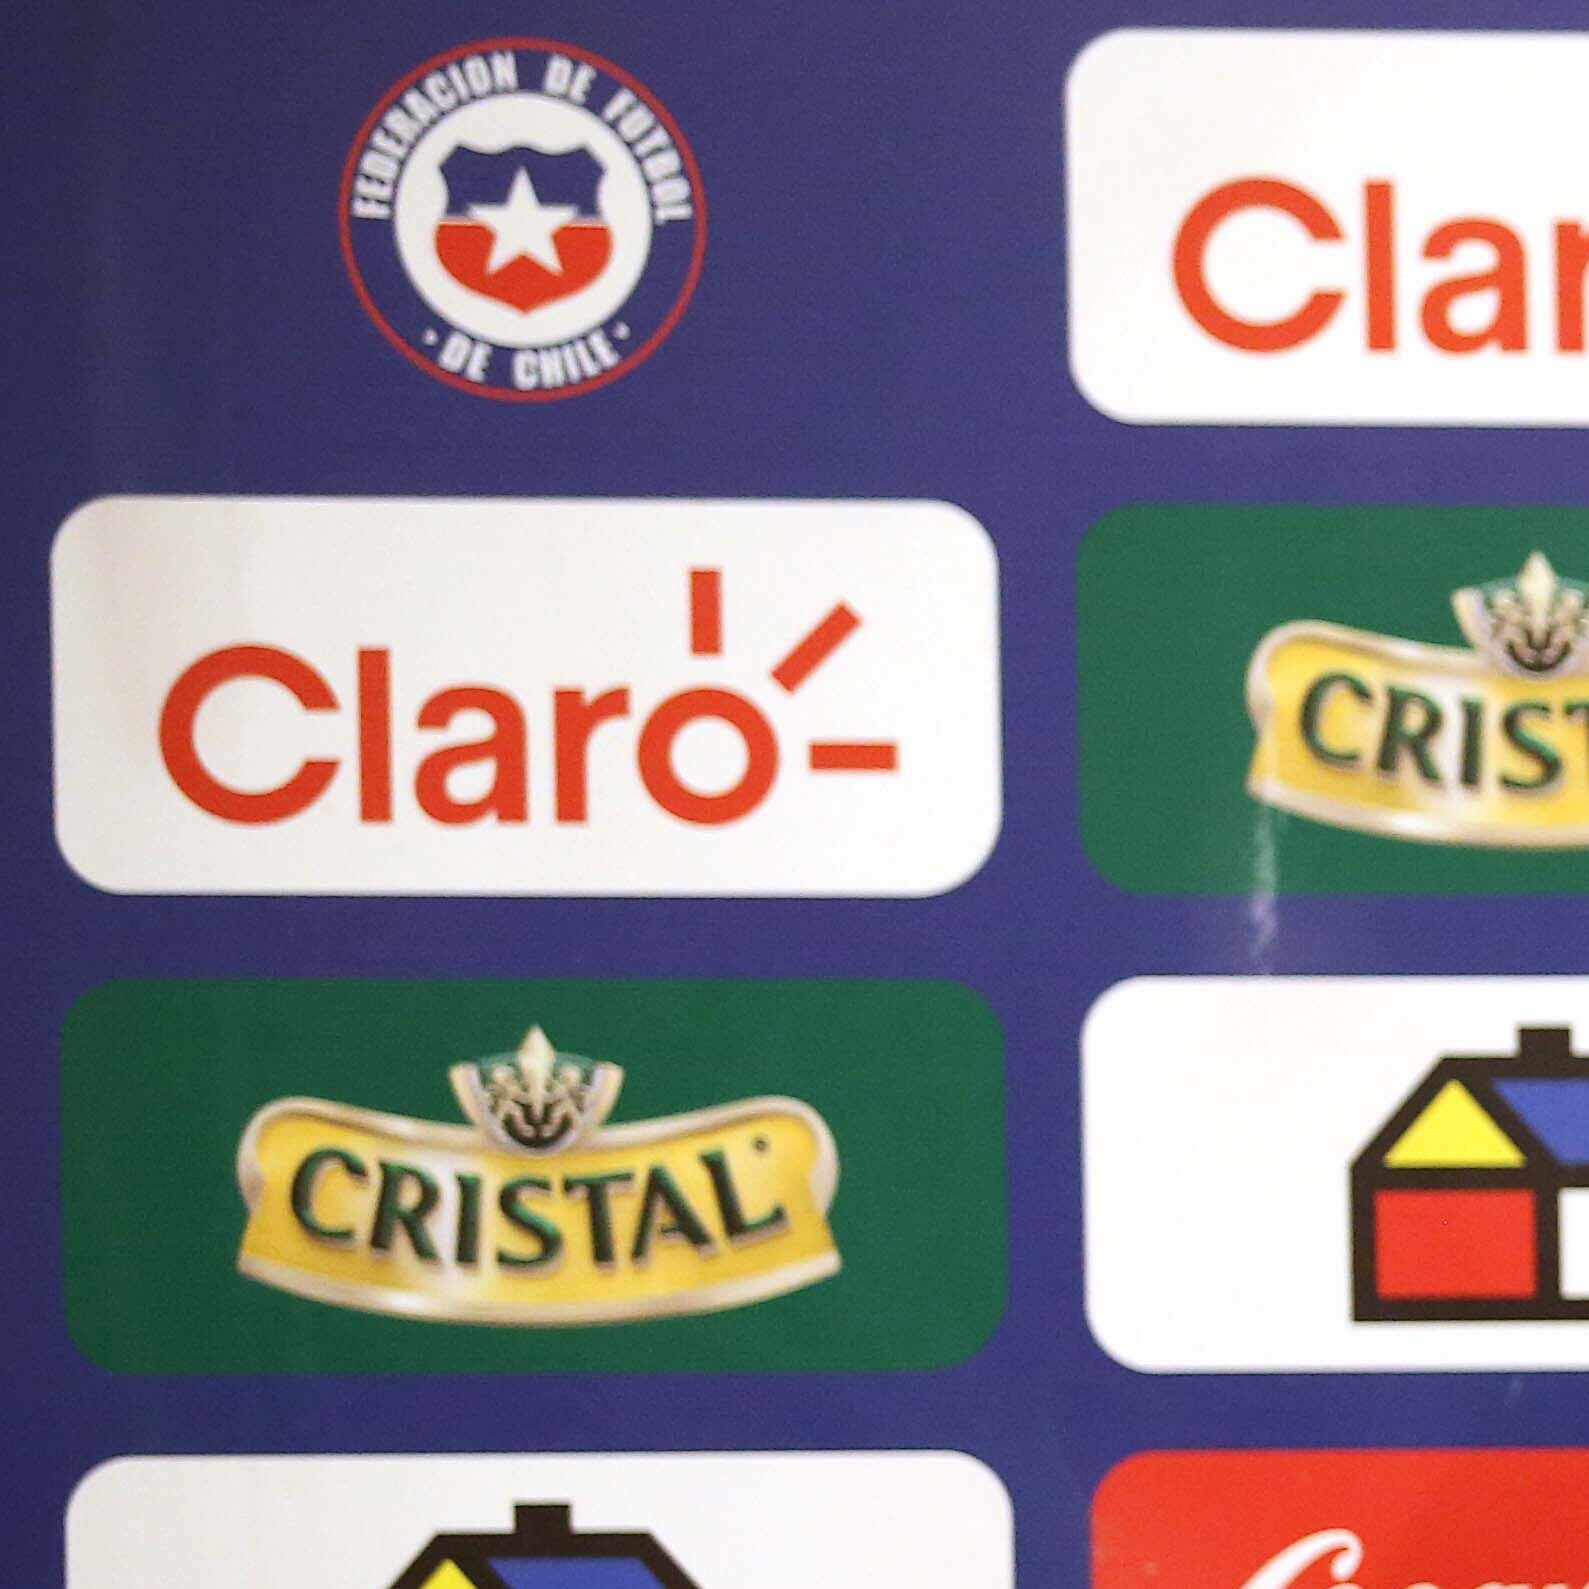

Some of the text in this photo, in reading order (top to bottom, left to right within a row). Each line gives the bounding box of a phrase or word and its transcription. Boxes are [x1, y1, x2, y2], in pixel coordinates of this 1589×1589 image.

[542, 52, 597, 105] DE
[438, 328, 622, 391] DE CHILE
[157, 643, 780, 828] Claro
[288, 1144, 790, 1271] CRISTAL
